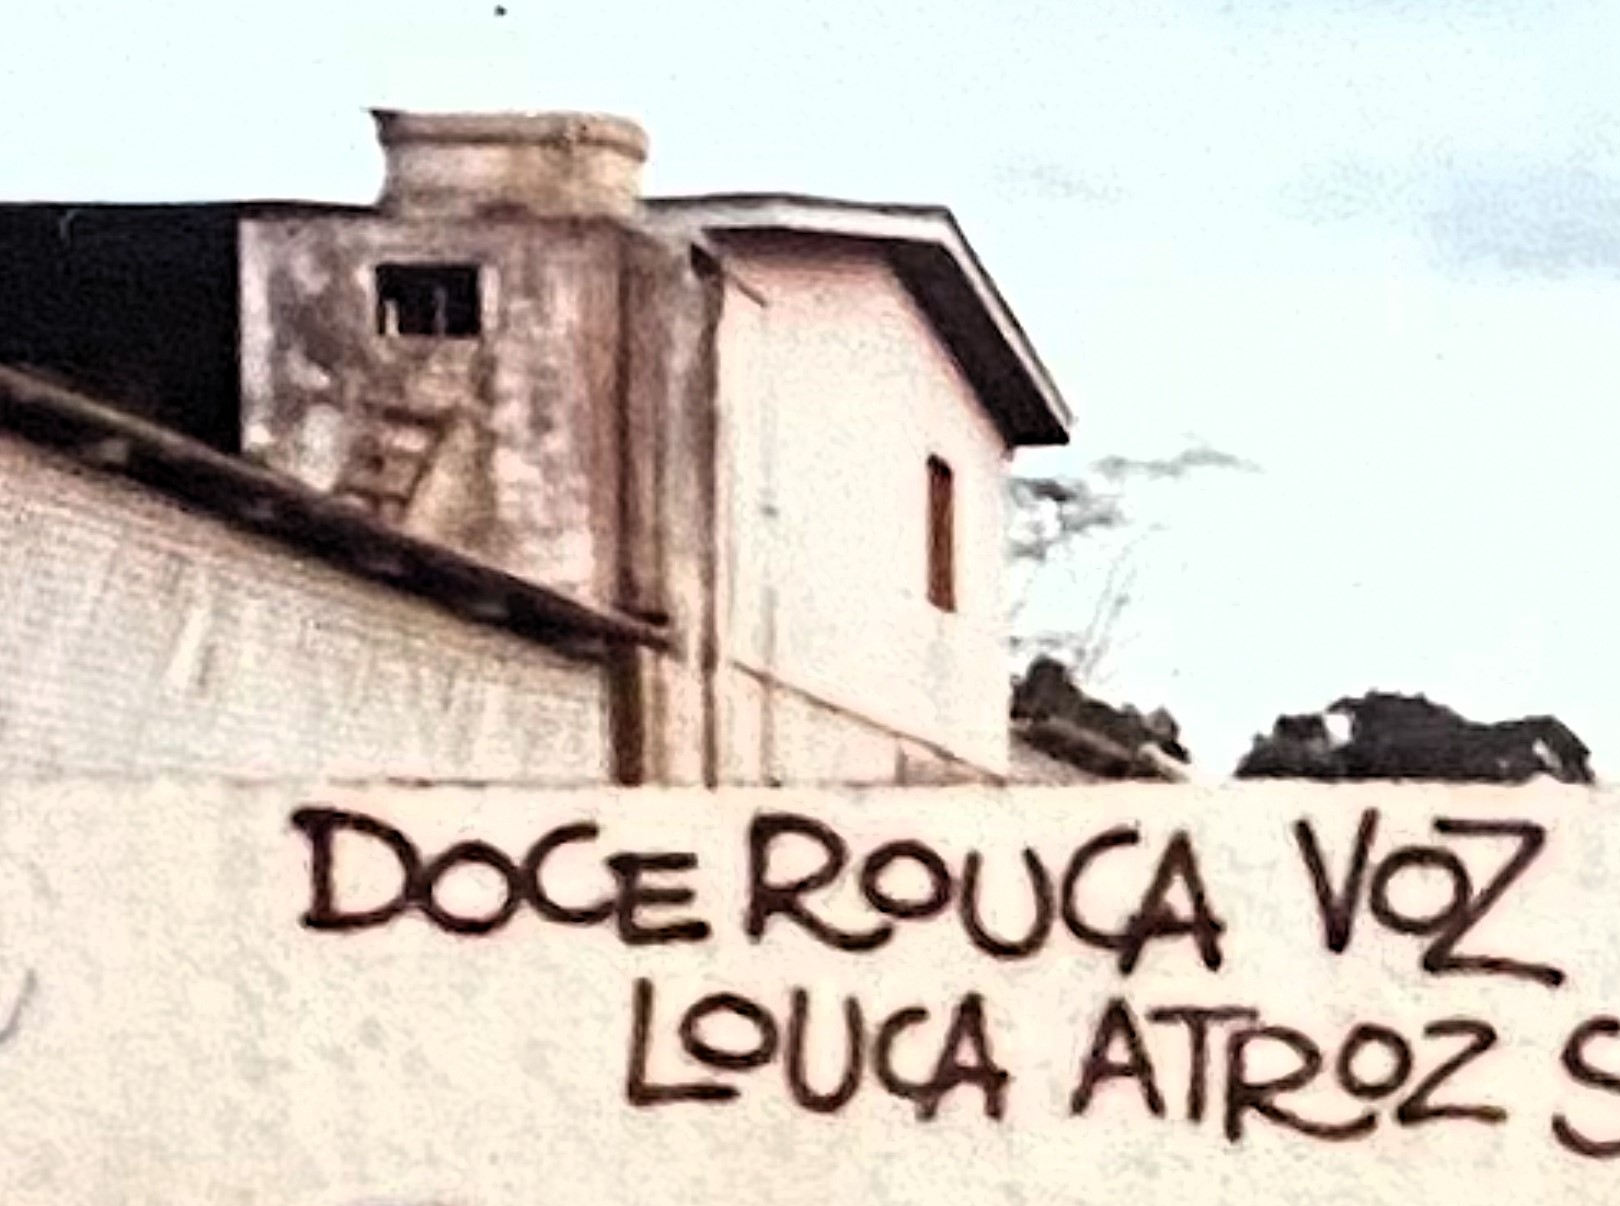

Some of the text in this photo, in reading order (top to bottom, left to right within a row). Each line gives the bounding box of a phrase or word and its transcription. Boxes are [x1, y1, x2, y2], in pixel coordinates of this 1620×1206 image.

[291, 805, 1565, 987] DOCE ROUCA VOZ
[627, 976, 1010, 1123] LOUCA
[1070, 996, 1508, 1144] ATROZ
